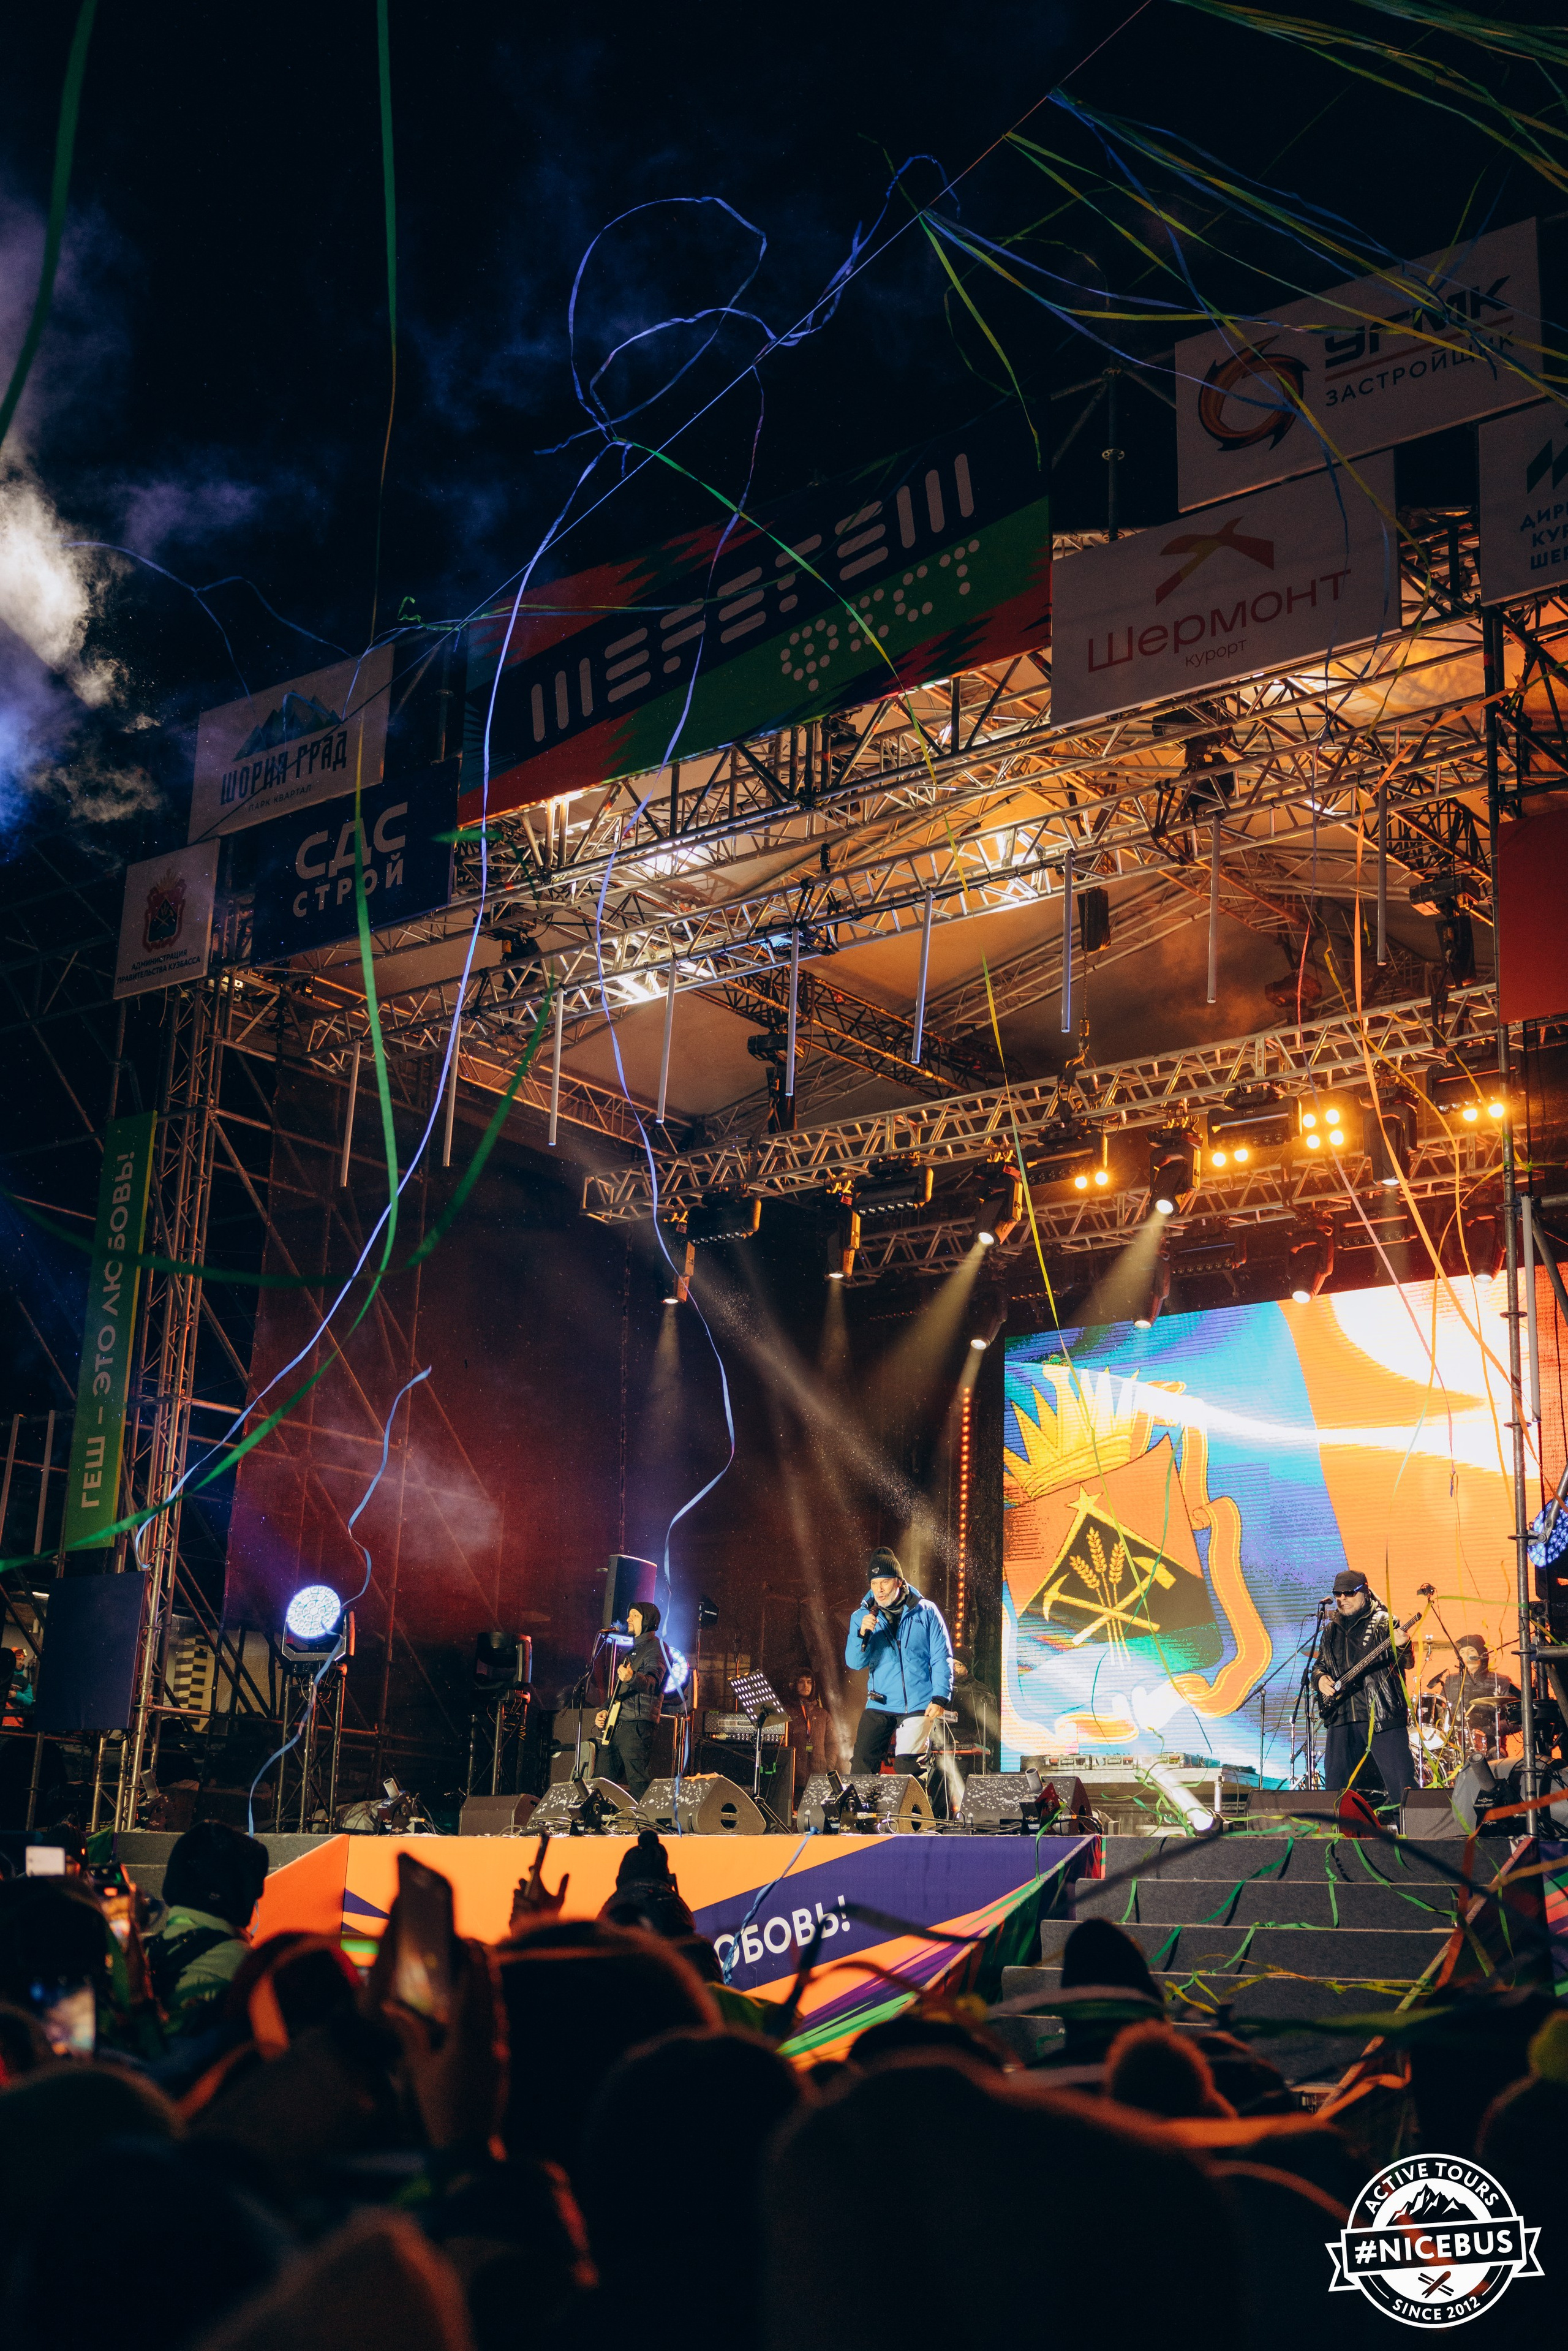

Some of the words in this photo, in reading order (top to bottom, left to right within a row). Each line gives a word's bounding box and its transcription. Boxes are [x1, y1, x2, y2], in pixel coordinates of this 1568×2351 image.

[1326, 330, 1513, 406] ЗАСТРОЙЩК
[1520, 502, 1568, 531] ДИР
[1185, 640, 1247, 668] курорт
[249, 798, 270, 812] ПАРК
[273, 784, 312, 804] КВАРТАЛ
[295, 801, 408, 880] СДС
[293, 852, 404, 918] СТРОЙ
[117, 965, 167, 984] ПРАВИТЕЛЬСТВА
[168, 956, 200, 971] КУЗБАССА
[131, 949, 187, 970] АДМИНИСТРАЦИЯ
[81, 1436, 105, 1508] ГЕШ
[93, 1324, 116, 1396] ЭТО
